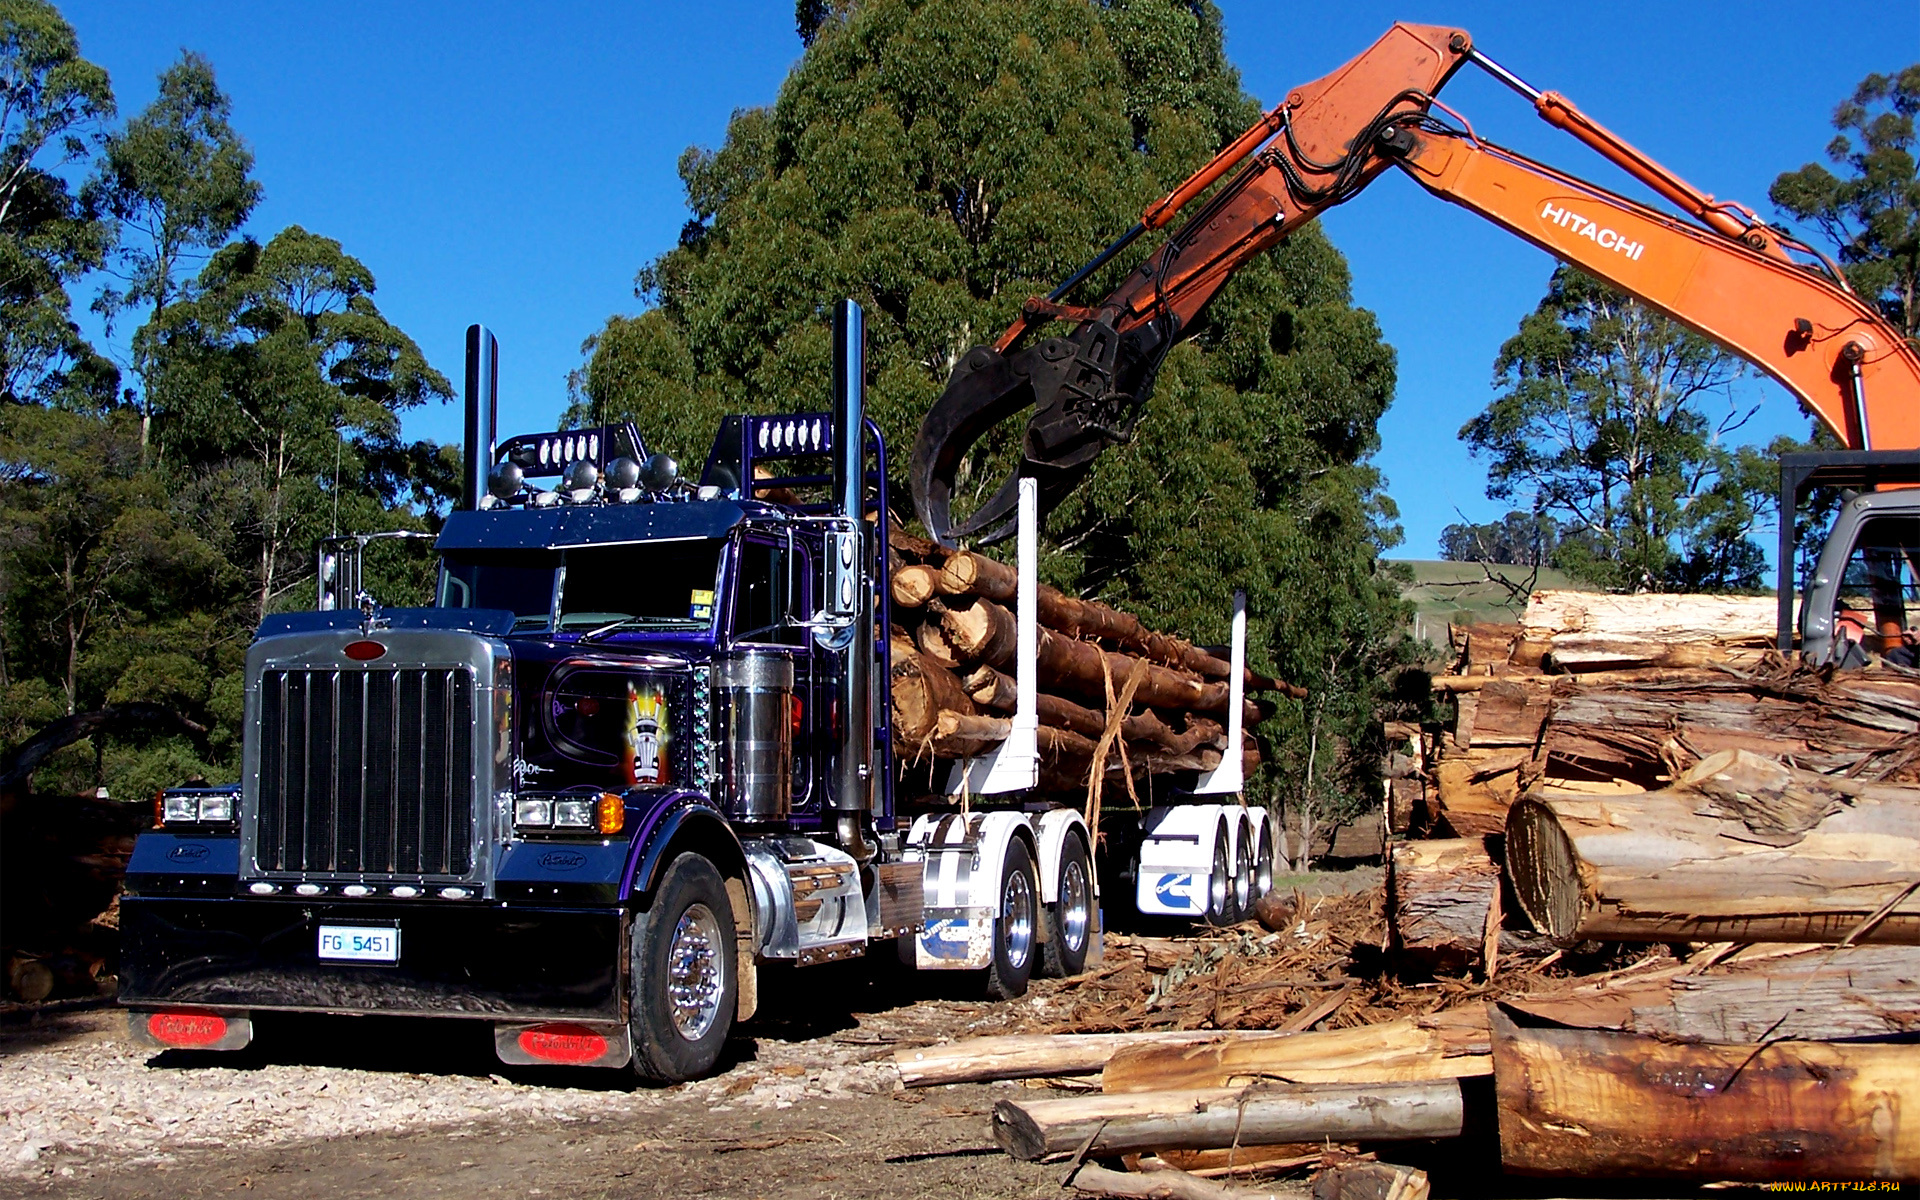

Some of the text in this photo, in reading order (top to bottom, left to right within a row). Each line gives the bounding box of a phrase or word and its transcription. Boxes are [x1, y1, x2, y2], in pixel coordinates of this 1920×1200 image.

[1540, 202, 1645, 261] HITACHI
[322, 934, 390, 953] FG 5451
